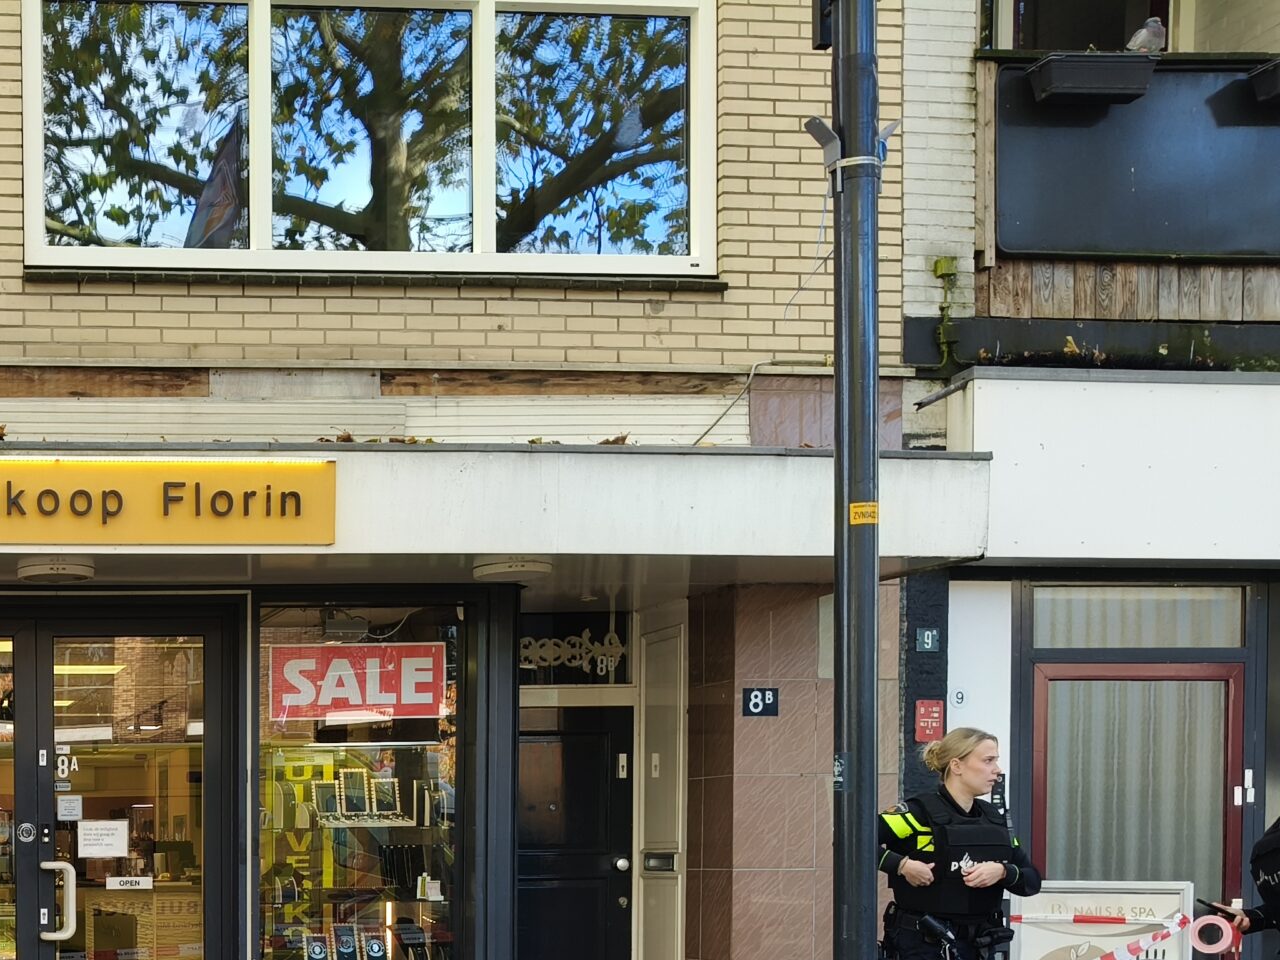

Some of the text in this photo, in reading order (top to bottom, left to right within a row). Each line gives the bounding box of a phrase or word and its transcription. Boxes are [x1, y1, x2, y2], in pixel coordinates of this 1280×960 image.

[161, 480, 304, 519] Florin
[923, 629, 937, 649] 9A
[596, 655, 616, 676] 8B
[281, 657, 434, 706] SALE
[748, 690, 774, 713] 8B
[955, 691, 965, 705] 9
[56, 755, 79, 779] 8A
[118, 879, 141, 888] OPEN
[1073, 905, 1113, 918] NAILS
[1116, 906, 1126, 918] &
[1131, 905, 1157, 919] SPA
